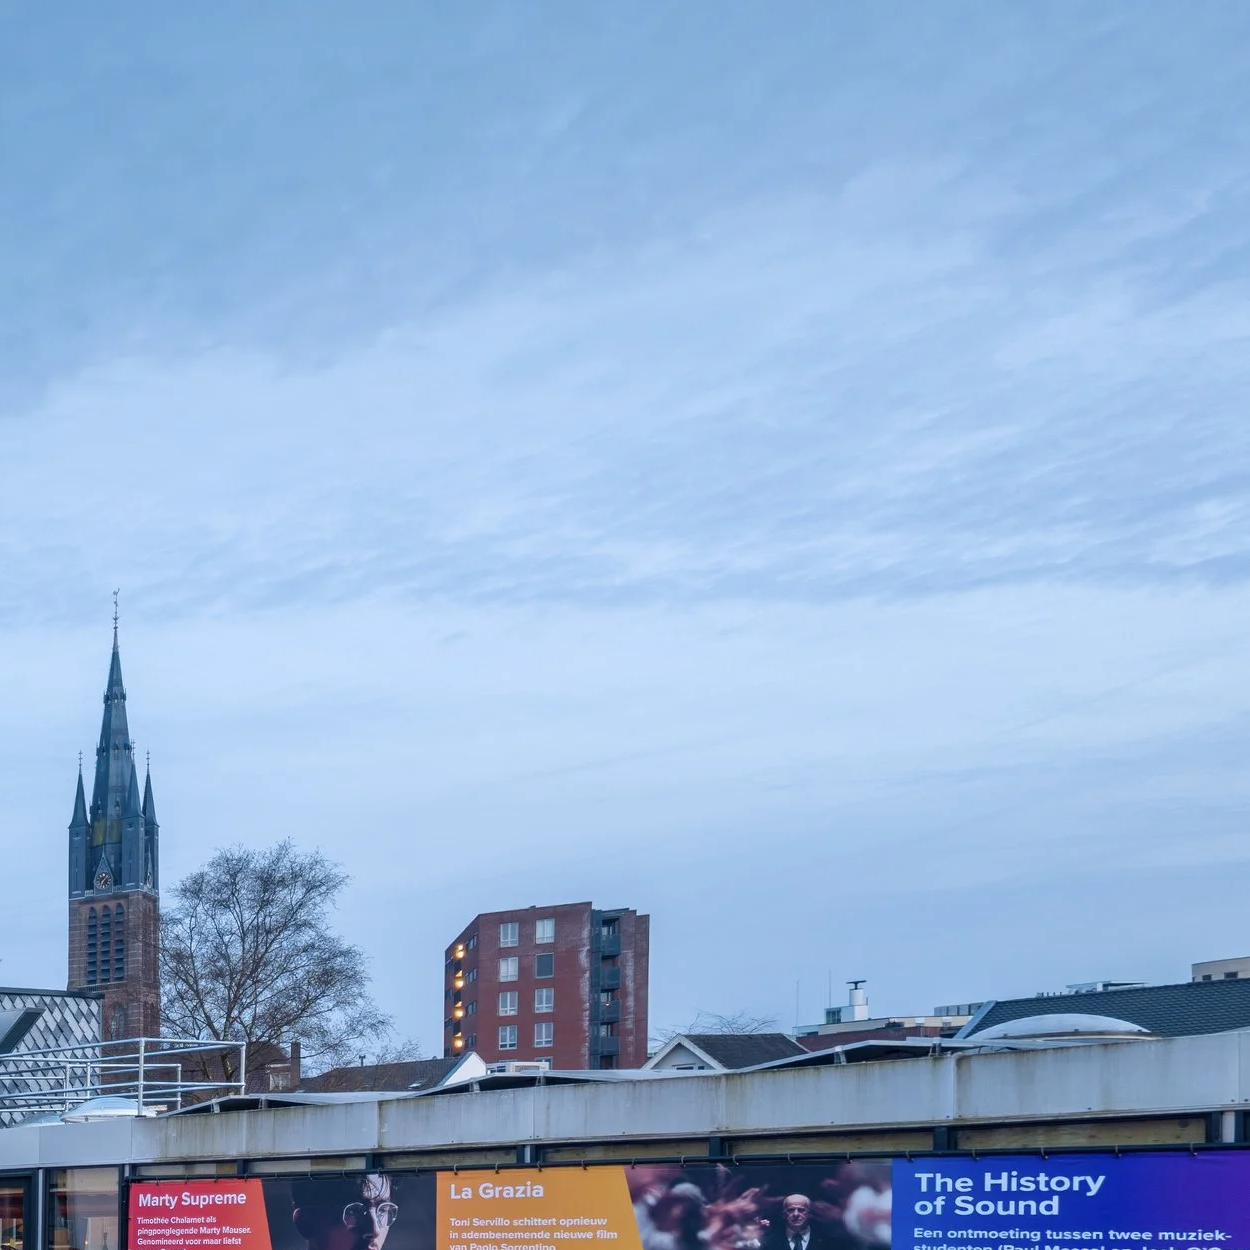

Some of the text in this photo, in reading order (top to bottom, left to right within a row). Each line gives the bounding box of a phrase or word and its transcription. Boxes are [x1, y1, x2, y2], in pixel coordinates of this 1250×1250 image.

[450, 1181, 544, 1199] La Grazia
[914, 1171, 1106, 1197] The History
[138, 1192, 247, 1209] Marty Supreme
[914, 1195, 1059, 1216] of Sound
[137, 1216, 169, 1225] Timothée
[170, 1216, 205, 1224] Chalamet
[449, 1216, 607, 1228] Toni Servillo schittert opnieuw
[137, 1226, 251, 1237] pingponglegende Marty Mauser.
[449, 1229, 618, 1240] in adembenemende nieuwe film
[913, 1227, 1233, 1242] Een ontmoeting tussen twee muziek-
[137, 1237, 184, 1246] Genomineerd
[223, 1237, 242, 1245] liefst
